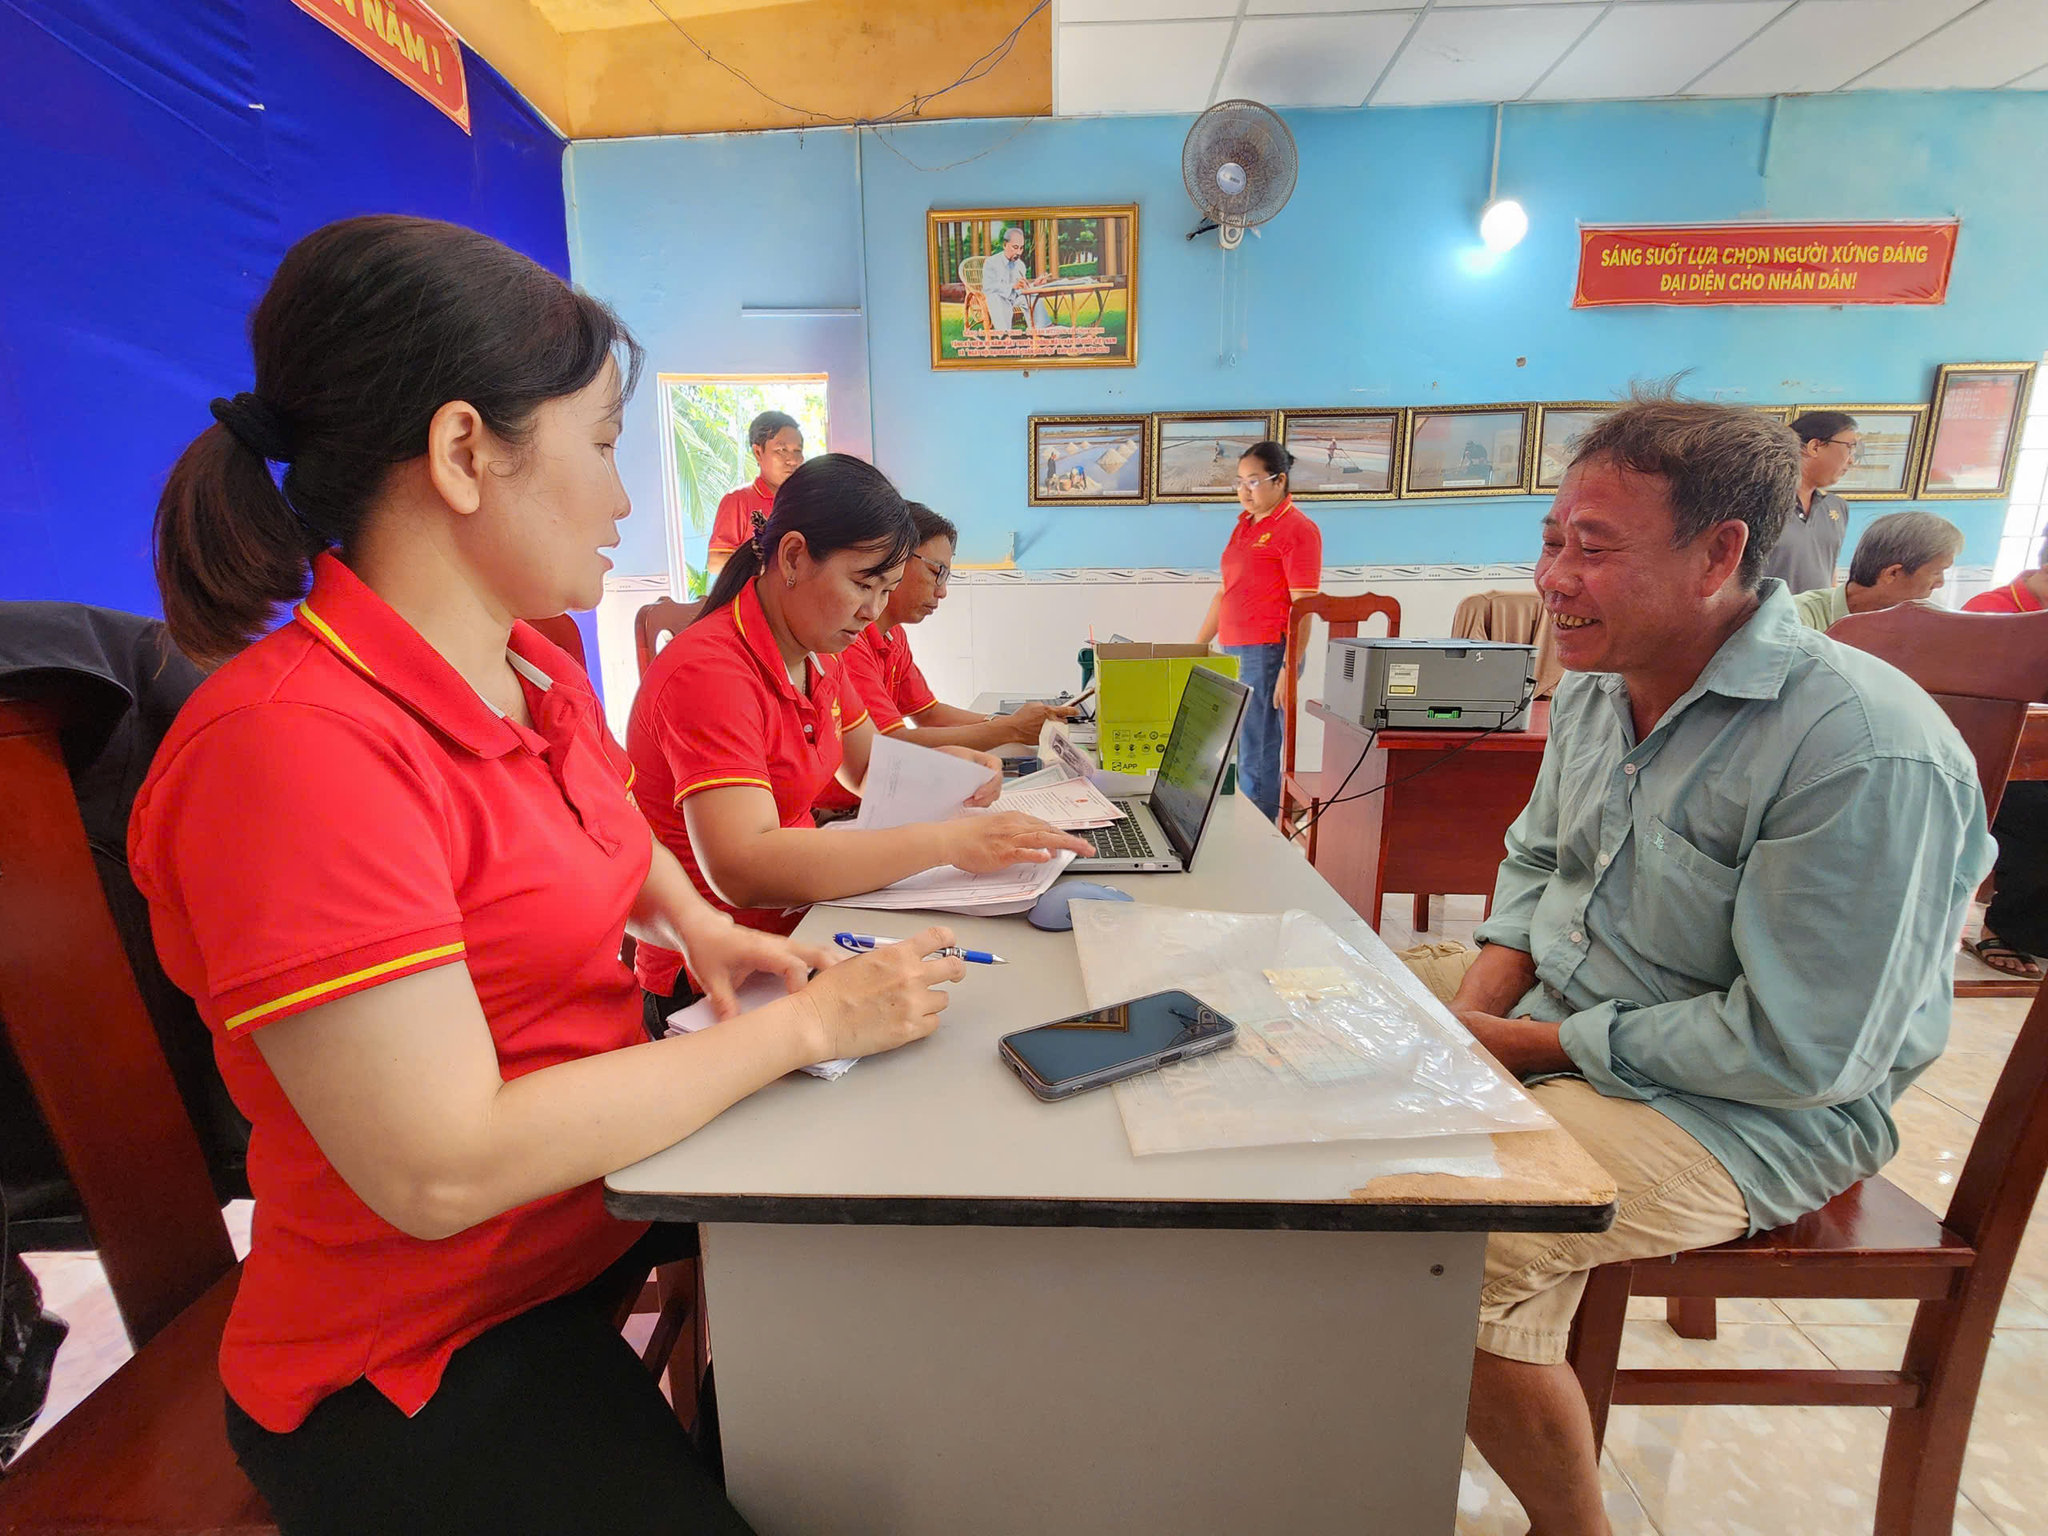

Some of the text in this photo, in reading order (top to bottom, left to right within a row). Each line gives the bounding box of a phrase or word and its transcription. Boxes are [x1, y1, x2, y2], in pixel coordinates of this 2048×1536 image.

[1601, 241, 1928, 270] SÁNG SUỐT LỰA CHỌN NGƯỜI XỨNG ĐÁNG
[1660, 268, 1858, 296] ĐẠI DIỆN CHO NHÂN DÂN!
